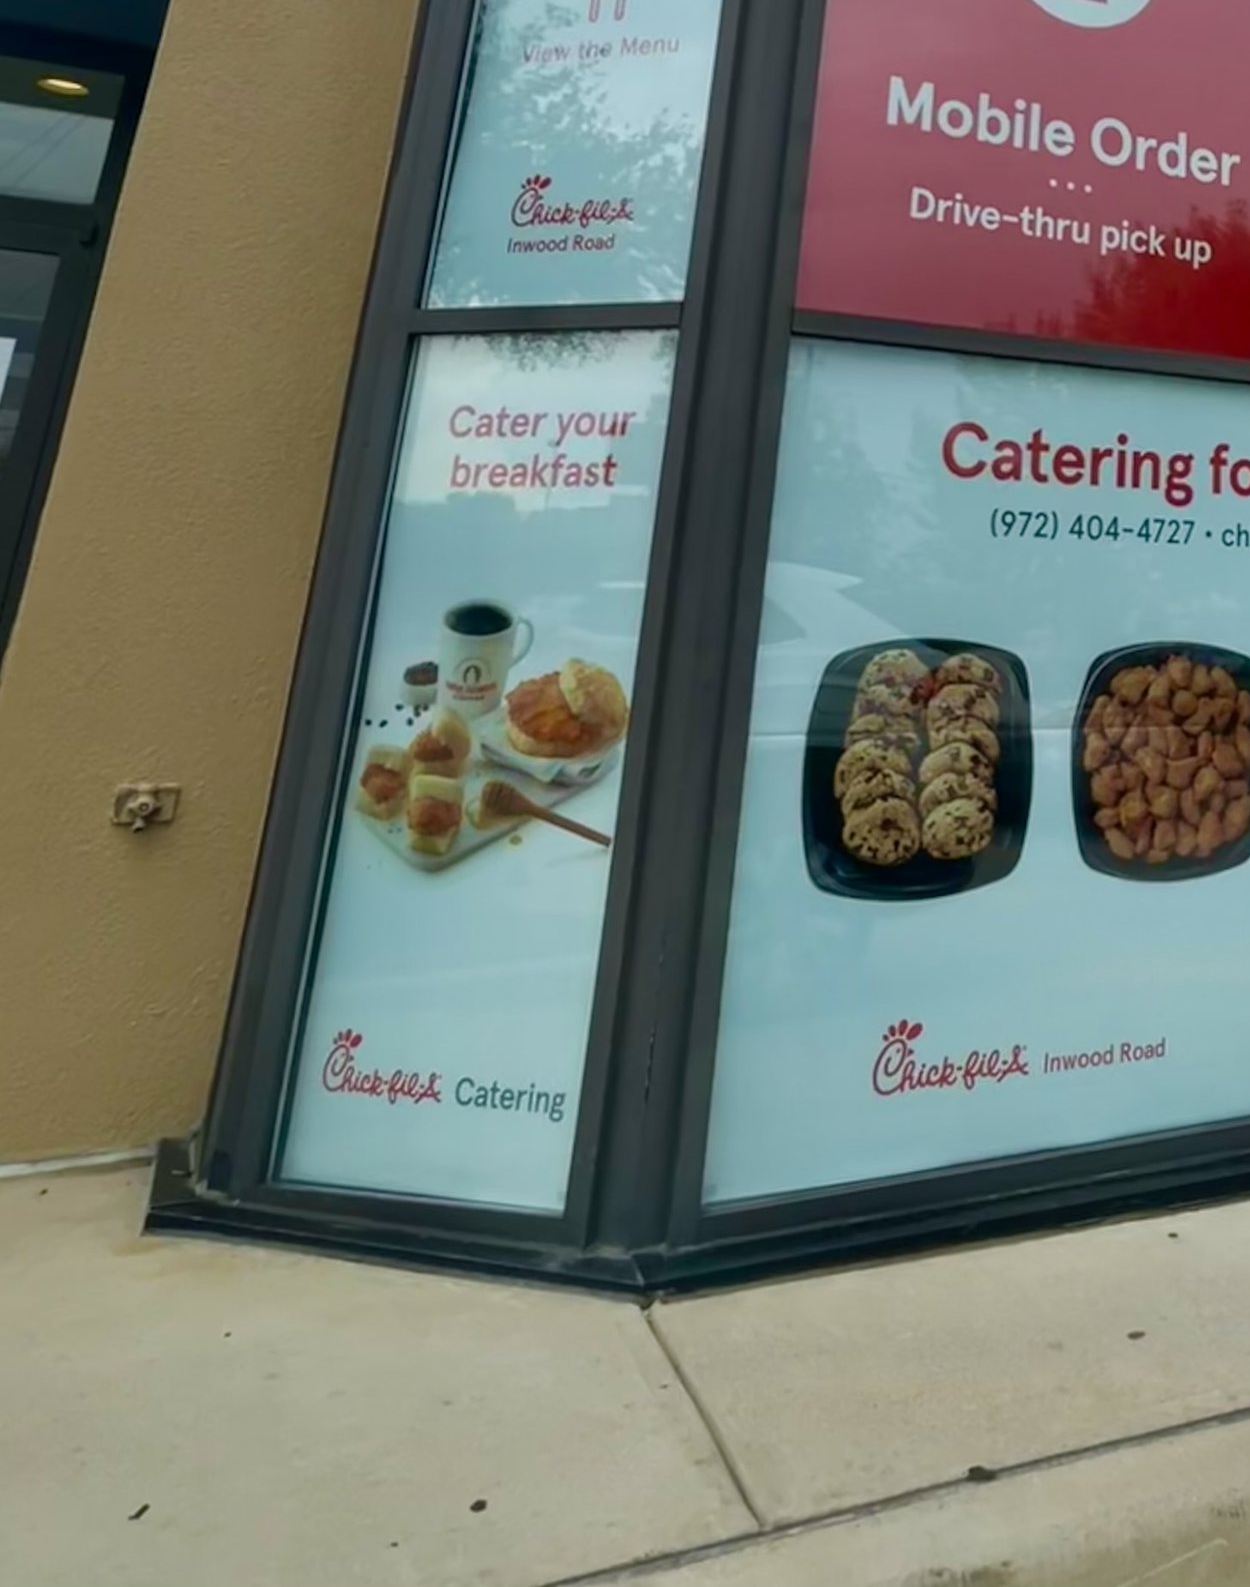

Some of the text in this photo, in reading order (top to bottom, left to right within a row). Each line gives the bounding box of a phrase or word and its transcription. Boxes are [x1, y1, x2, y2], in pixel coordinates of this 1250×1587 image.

[523, 37, 680, 63] View the Menu
[886, 75, 1240, 186] Mobile Order
[511, 174, 635, 228] Chick-fil-A
[909, 186, 1212, 269] Drive-thru pick up
[507, 234, 615, 254] Inwood Road
[449, 405, 637, 447] Cater your
[450, 452, 618, 488] breakfast
[942, 421, 1195, 507] Catering
[990, 508, 1059, 540] (972)
[1068, 514, 1195, 546] 404-4727
[322, 1028, 566, 1122] Chick-fil-A Catering
[873, 1019, 1167, 1096] Chick-fil-A Inwood Road
